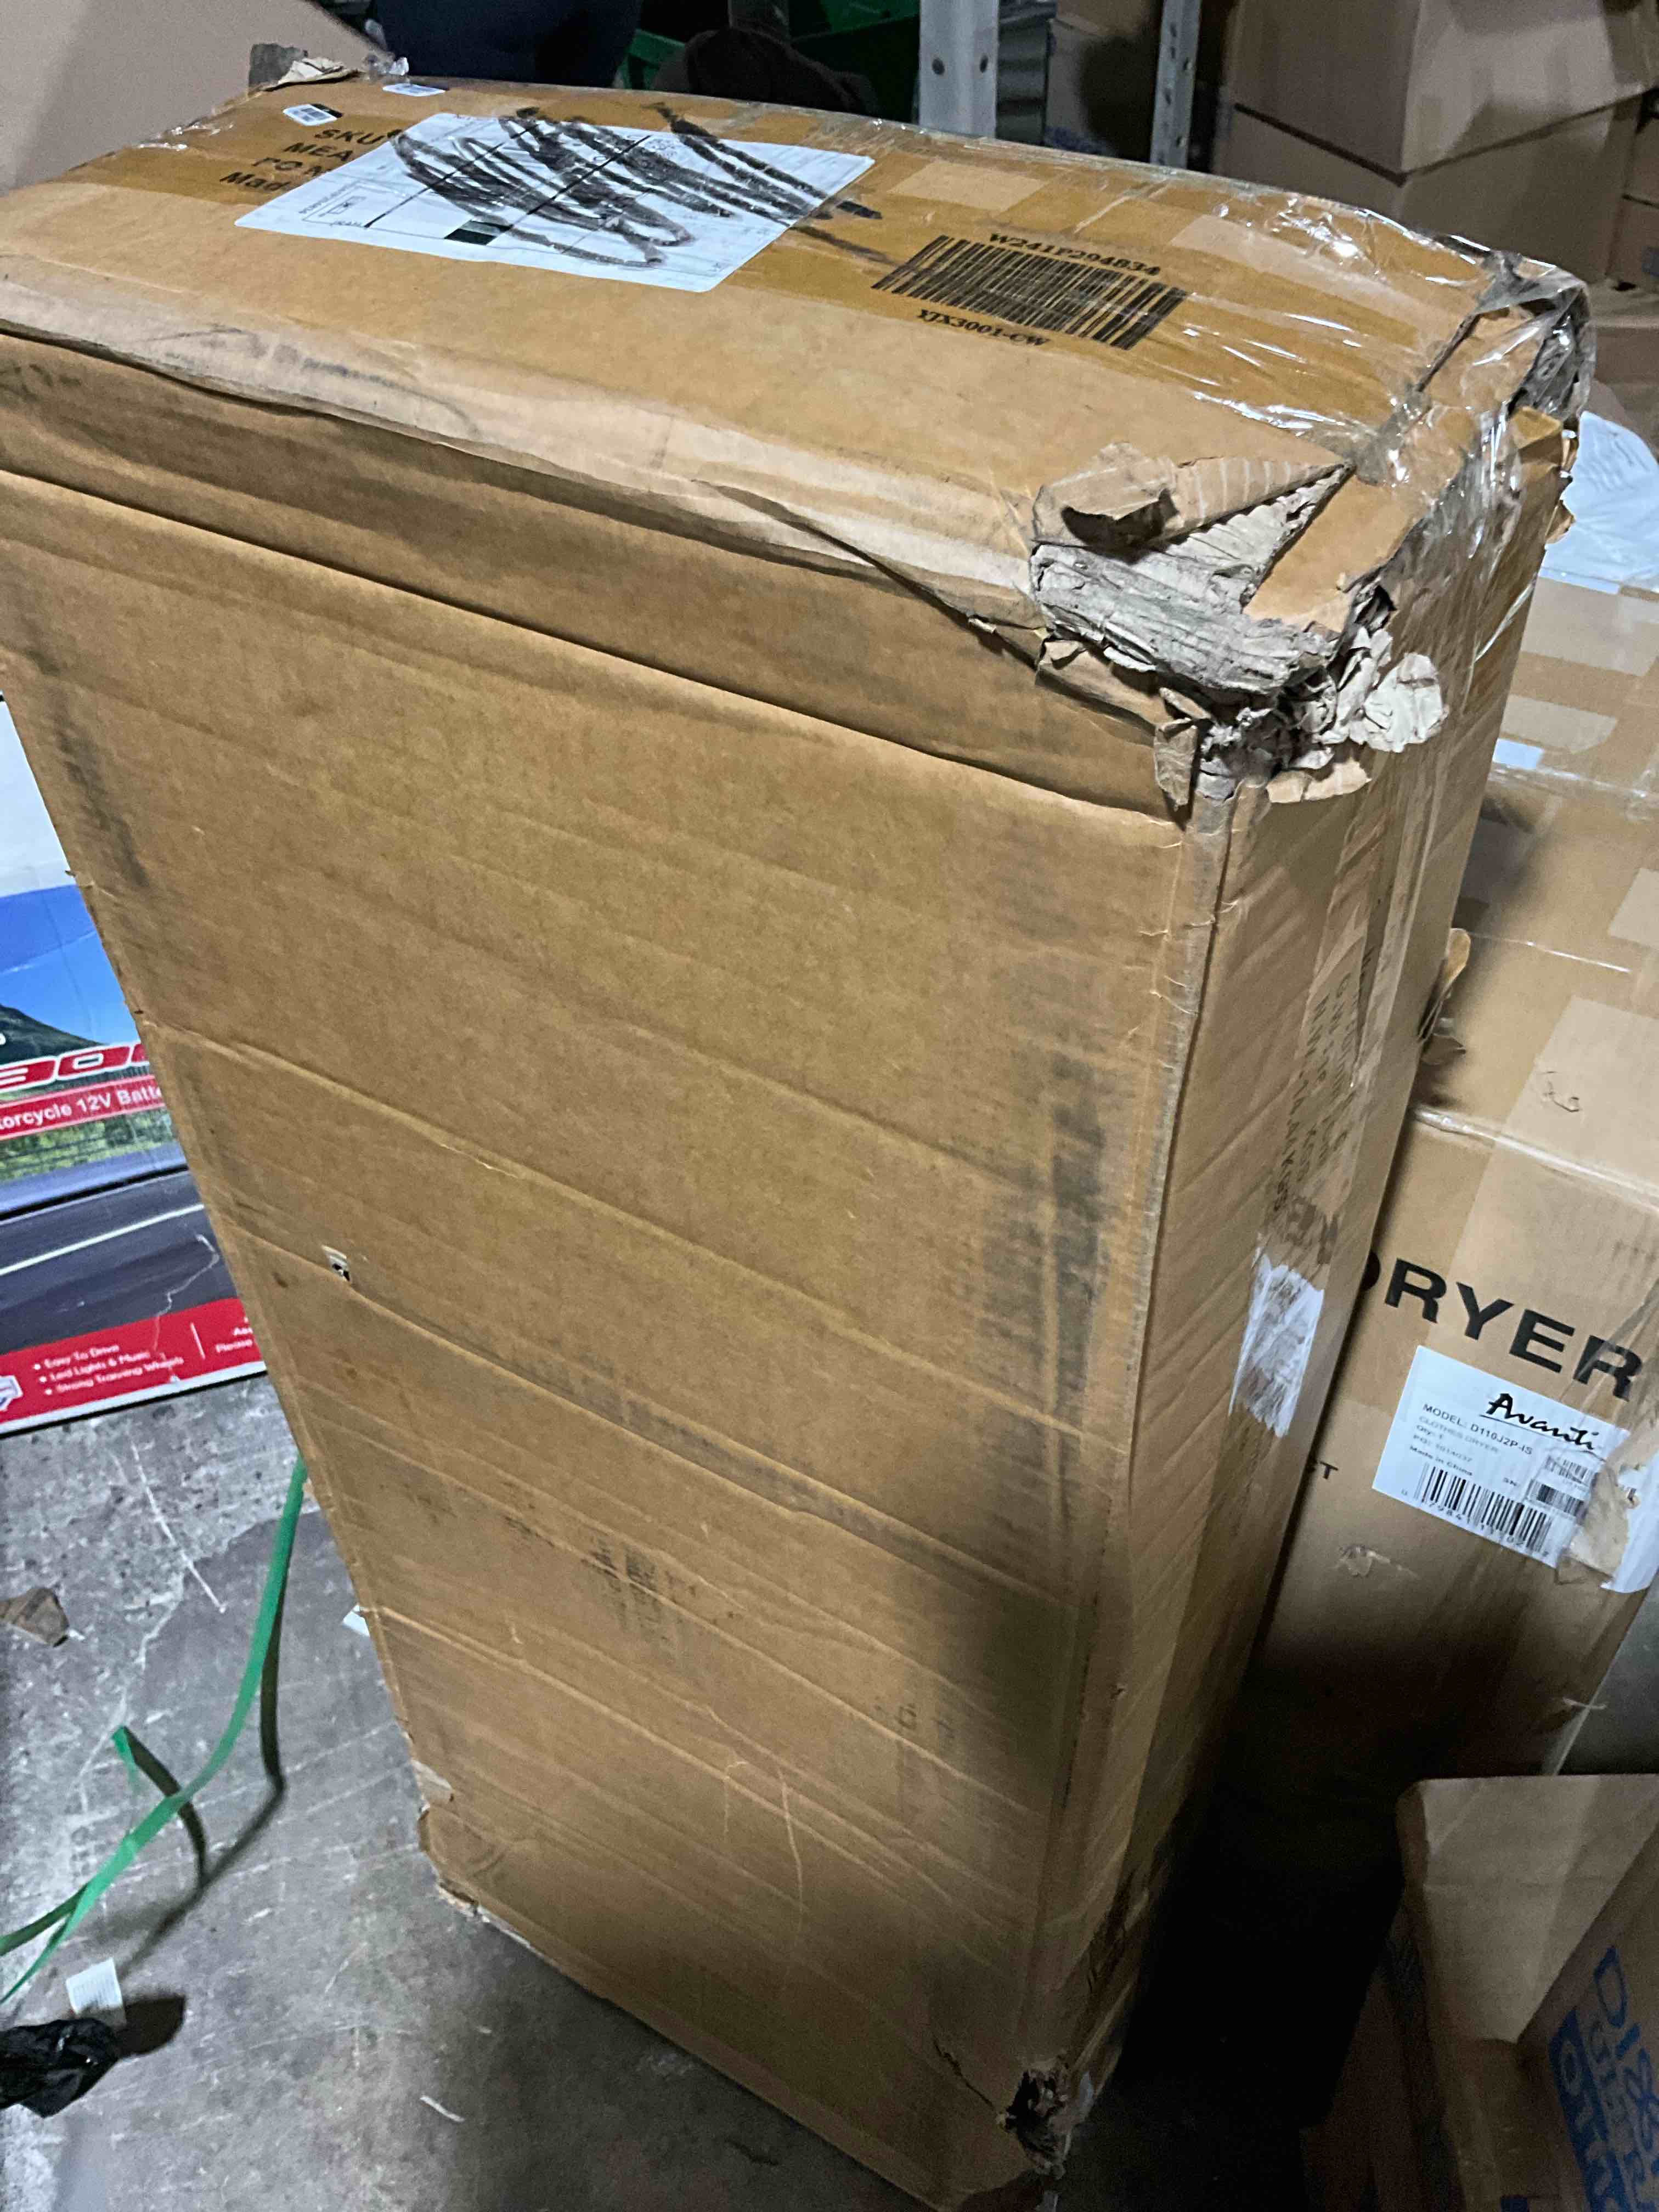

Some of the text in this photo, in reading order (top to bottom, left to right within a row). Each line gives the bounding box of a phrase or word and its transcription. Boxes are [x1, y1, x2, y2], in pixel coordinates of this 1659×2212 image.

[283, 143, 353, 161] MEA
[219, 172, 291, 191] Mad
[77, 1092, 111, 1113] 12V
[1486, 1393, 1599, 1450] Avanti
[1409, 1445, 1434, 1459] Made
[1447, 1460, 1473, 1476] China
